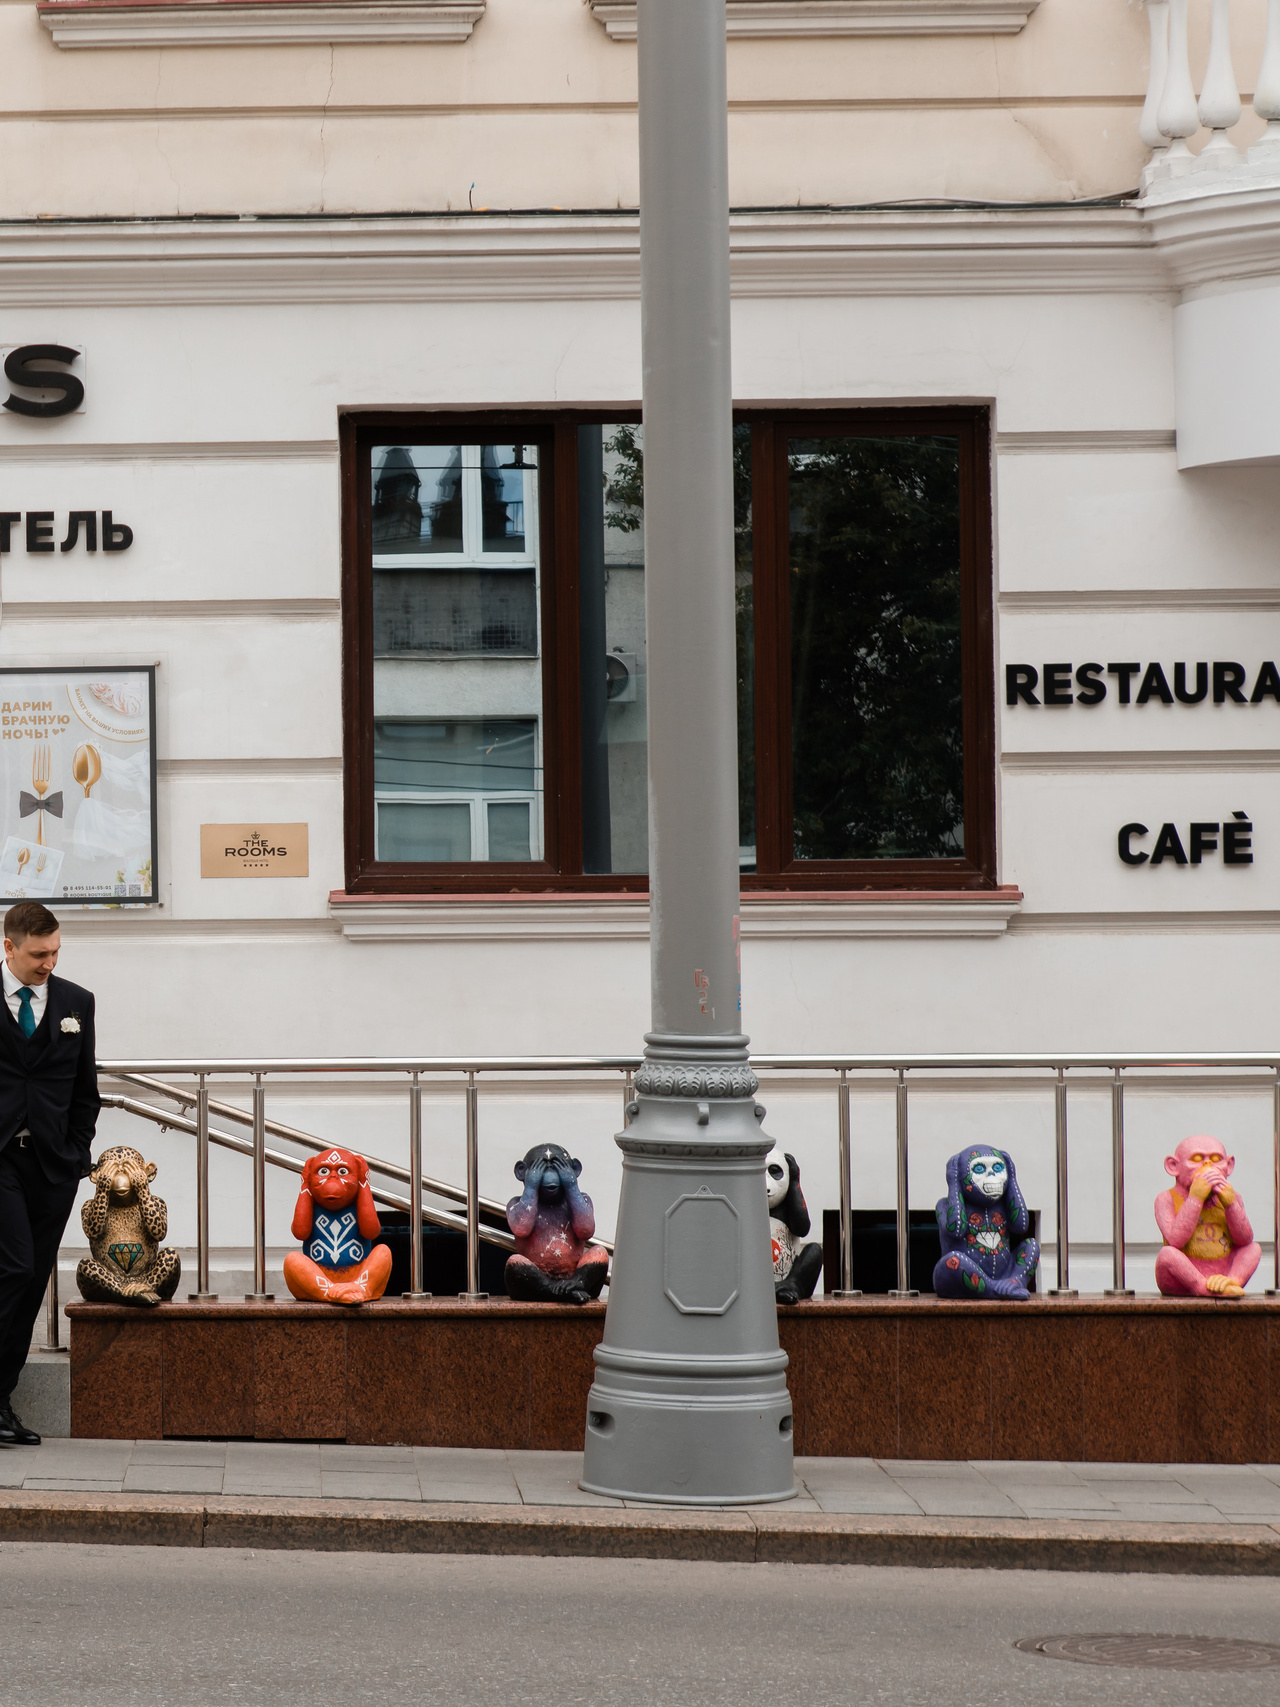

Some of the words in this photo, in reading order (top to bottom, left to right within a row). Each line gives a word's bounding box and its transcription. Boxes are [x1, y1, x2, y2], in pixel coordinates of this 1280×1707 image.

[1005, 661, 1280, 705] RESTAURA
[1, 701, 53, 713] ДАРИМ
[2, 714, 70, 726] БРАЧНУЮ
[2, 728, 49, 739] НОЧЬ!
[1117, 811, 1254, 865] CAFÈ
[225, 847, 287, 857] ROOMS
